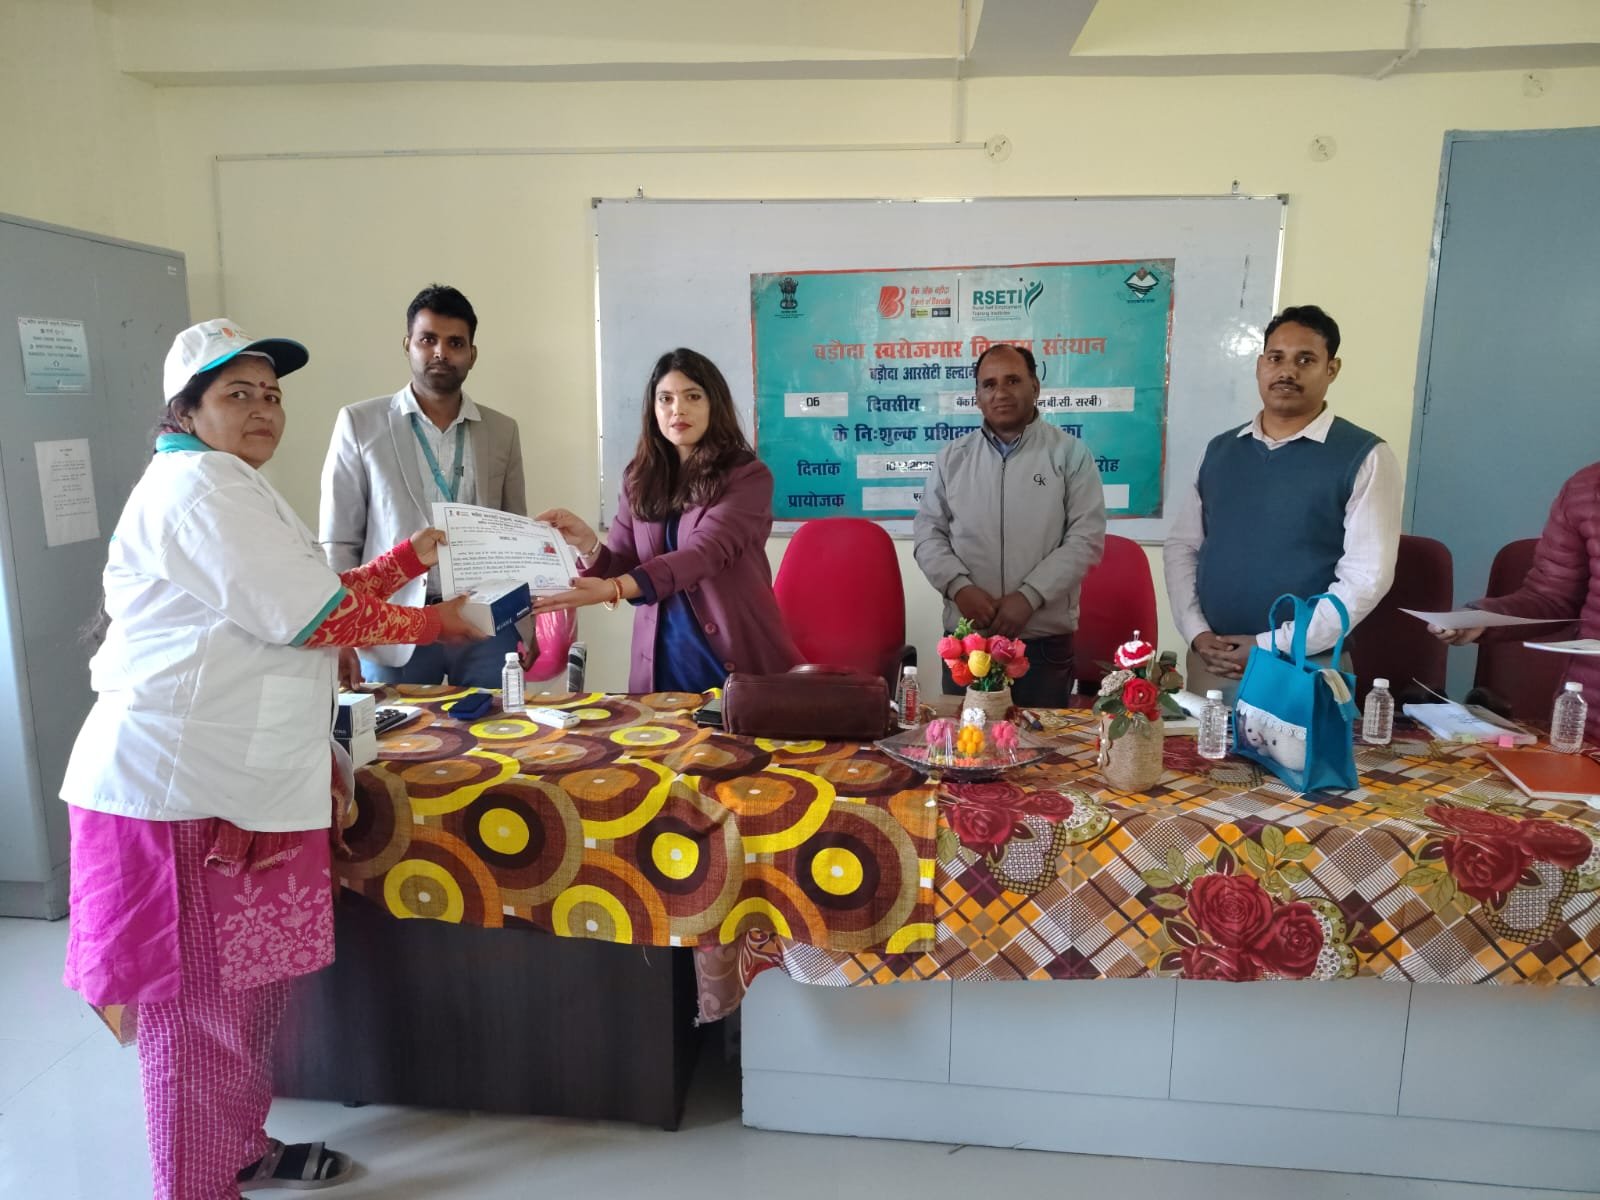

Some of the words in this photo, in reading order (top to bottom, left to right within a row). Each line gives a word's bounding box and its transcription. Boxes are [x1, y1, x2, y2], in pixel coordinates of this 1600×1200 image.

[973, 289, 1022, 305] RSETI
[813, 340, 866, 364] बड़ौदा
[874, 337, 964, 361] स्वरोजगार
[1042, 333, 1107, 356] संस्थान
[869, 364, 898, 384] बड़ौदा
[903, 363, 942, 381] आरसेटी
[806, 396, 820, 407] 06
[866, 394, 921, 412] दिवसीय
[832, 423, 849, 442] के
[797, 458, 842, 476] दिनांक
[788, 491, 845, 509] प्रायोजक
